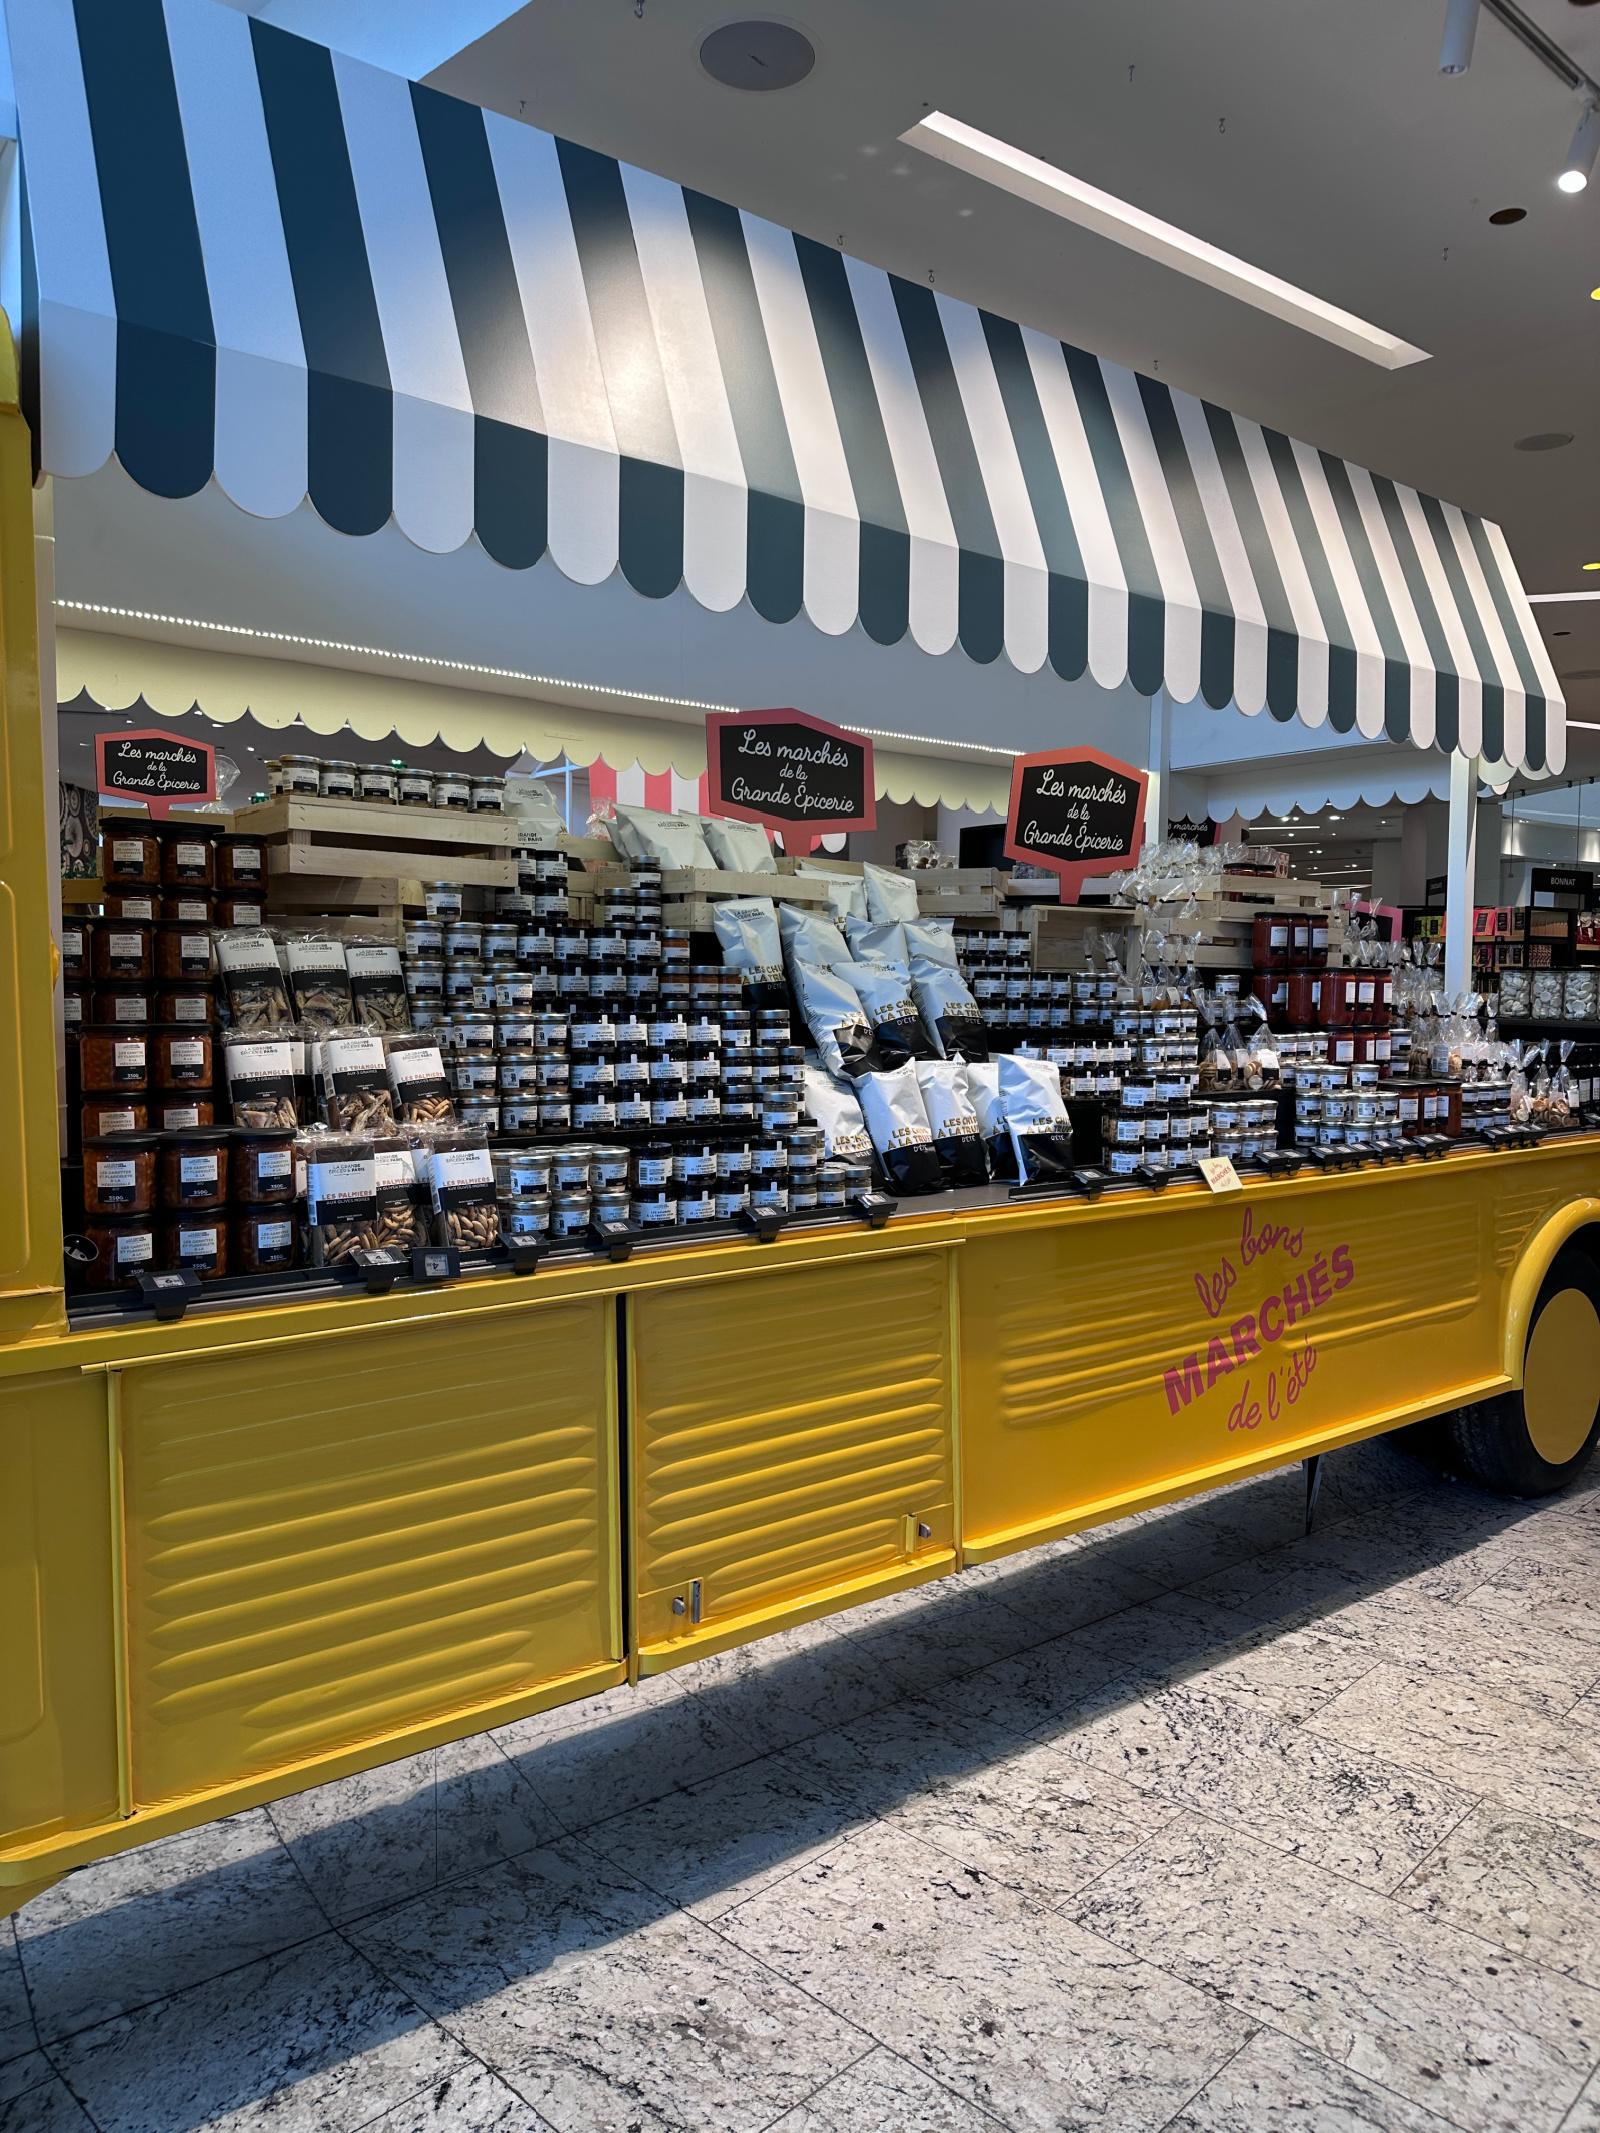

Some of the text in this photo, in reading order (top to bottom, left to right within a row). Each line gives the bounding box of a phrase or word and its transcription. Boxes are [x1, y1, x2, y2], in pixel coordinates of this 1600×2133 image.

[118, 742, 197, 763] Les marchés
[738, 729, 849, 768] Les marchés
[147, 761, 167, 772] de la
[780, 763, 808, 781] de la
[113, 771, 201, 791] Grande Épicerie
[1036, 769, 1126, 804] Les marchés
[731, 777, 854, 814] Grande Épicerie
[1067, 802, 1091, 821] de la
[1024, 820, 1124, 854] Grande Épicerie
[1550, 877, 1576, 886] BONNAT
[874, 1002, 894, 1016] LES
[249, 1069, 290, 1077] TRIANGLES
[350, 1063, 385, 1071] TRIANGLES
[414, 1072, 444, 1080] PALMIERS
[943, 1118, 961, 1128] LES
[1032, 1116, 1053, 1126] LES
[892, 1127, 911, 1138] LES
[949, 1126, 962, 1136] LA
[898, 1137, 912, 1147] LA
[456, 1176, 491, 1185] PALMIERS
[338, 1190, 373, 1198] PALMIERS
[1194, 1207, 1304, 1319] les bons
[1163, 1244, 1355, 1416] MARCHÉS
[1227, 1379, 1263, 1432] de
